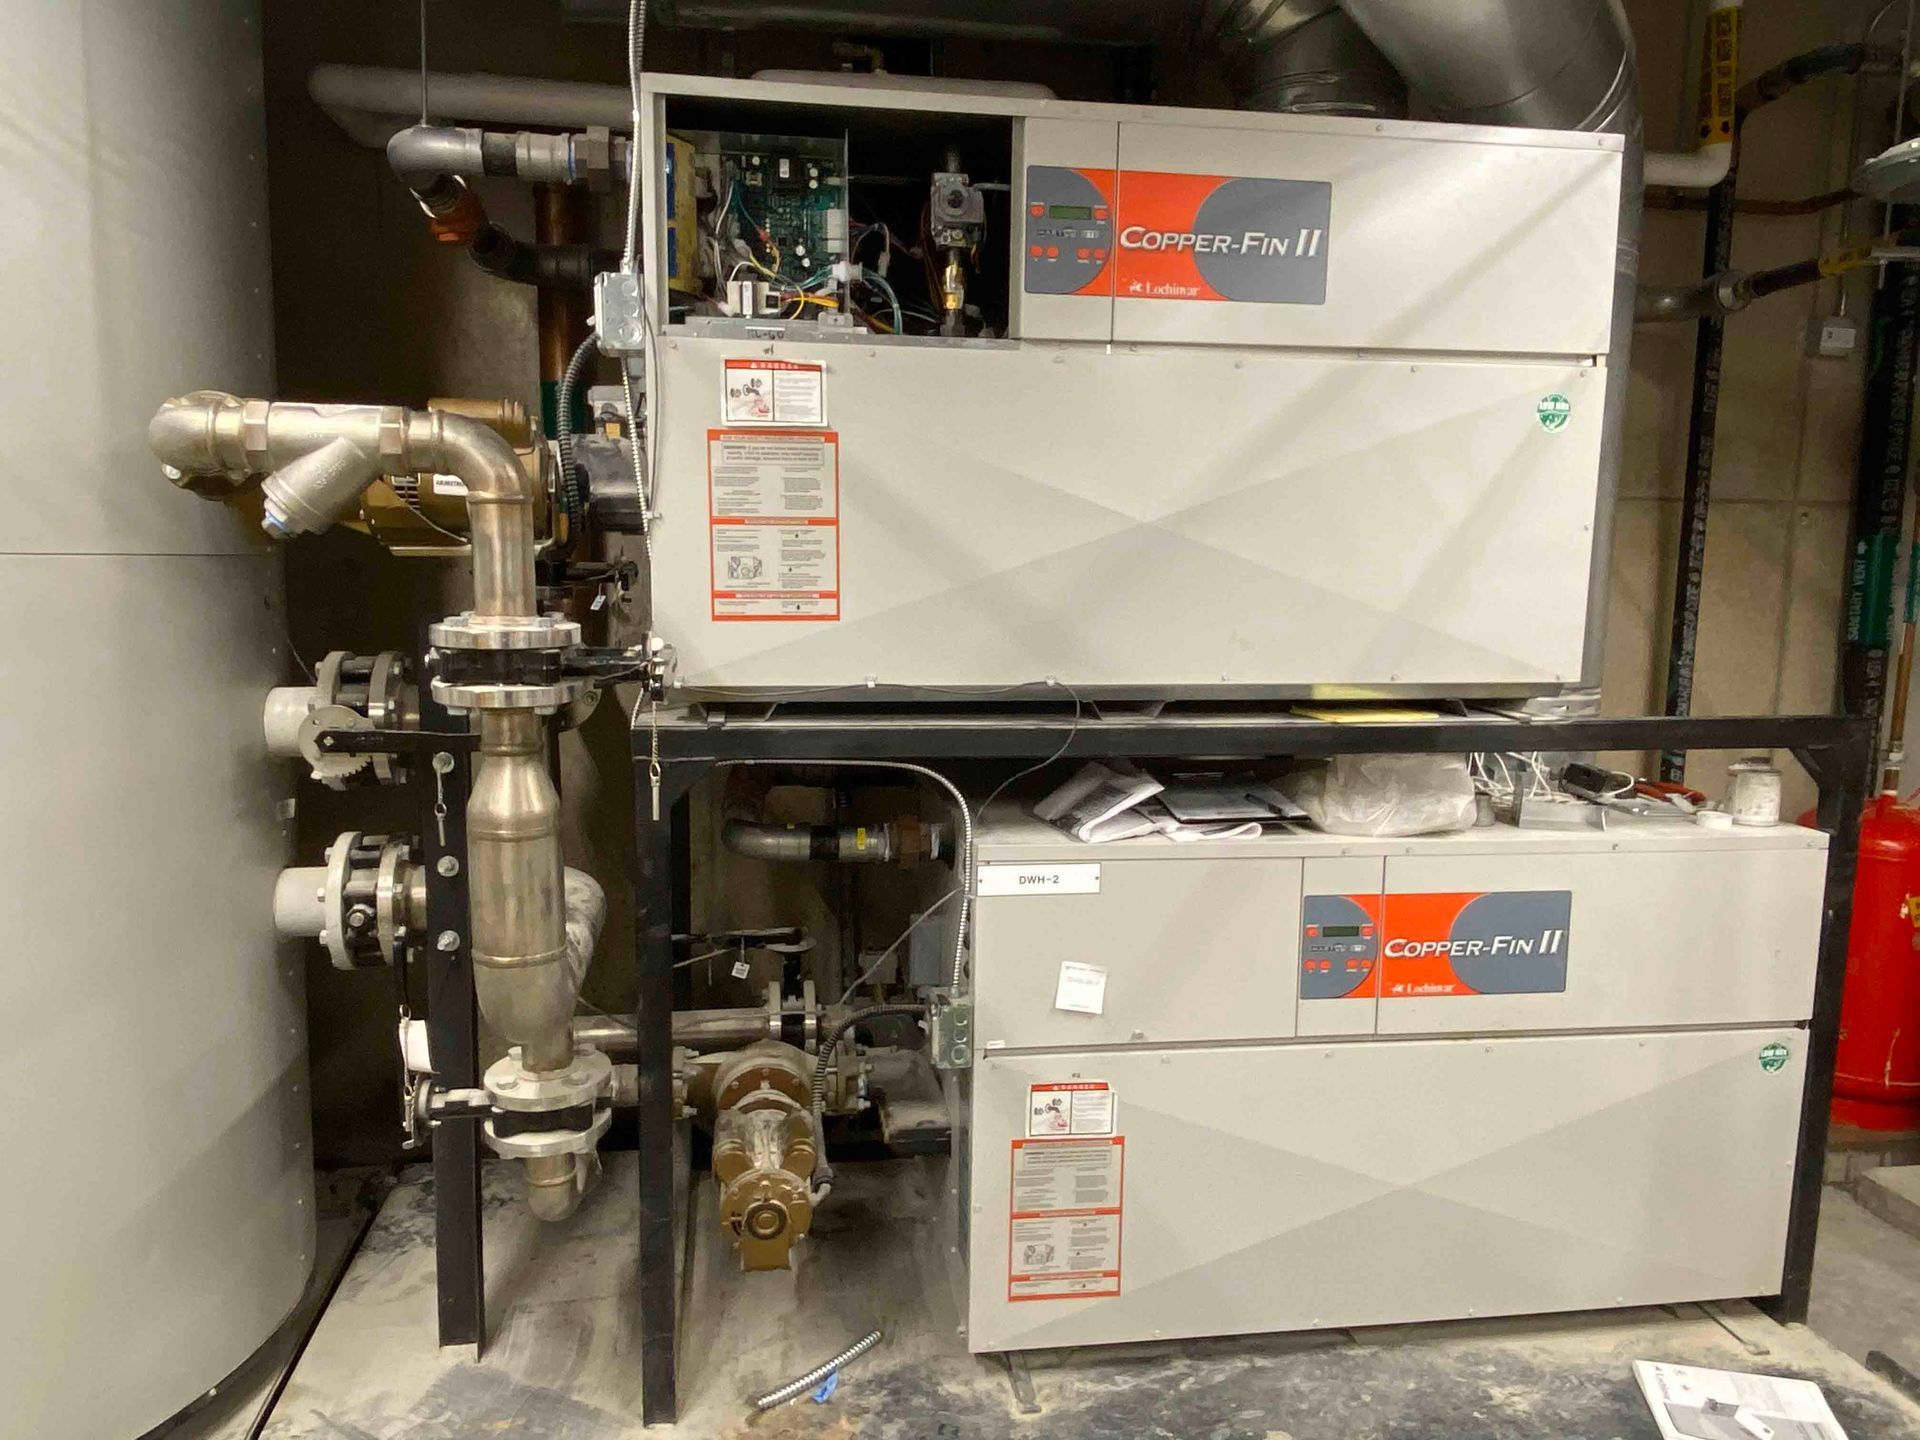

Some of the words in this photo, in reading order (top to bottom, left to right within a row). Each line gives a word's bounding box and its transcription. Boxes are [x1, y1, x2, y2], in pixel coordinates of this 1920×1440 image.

[1295, 228, 1322, 257] II
[1018, 874, 1060, 885] DWH-2
[1538, 930, 1563, 954] II
